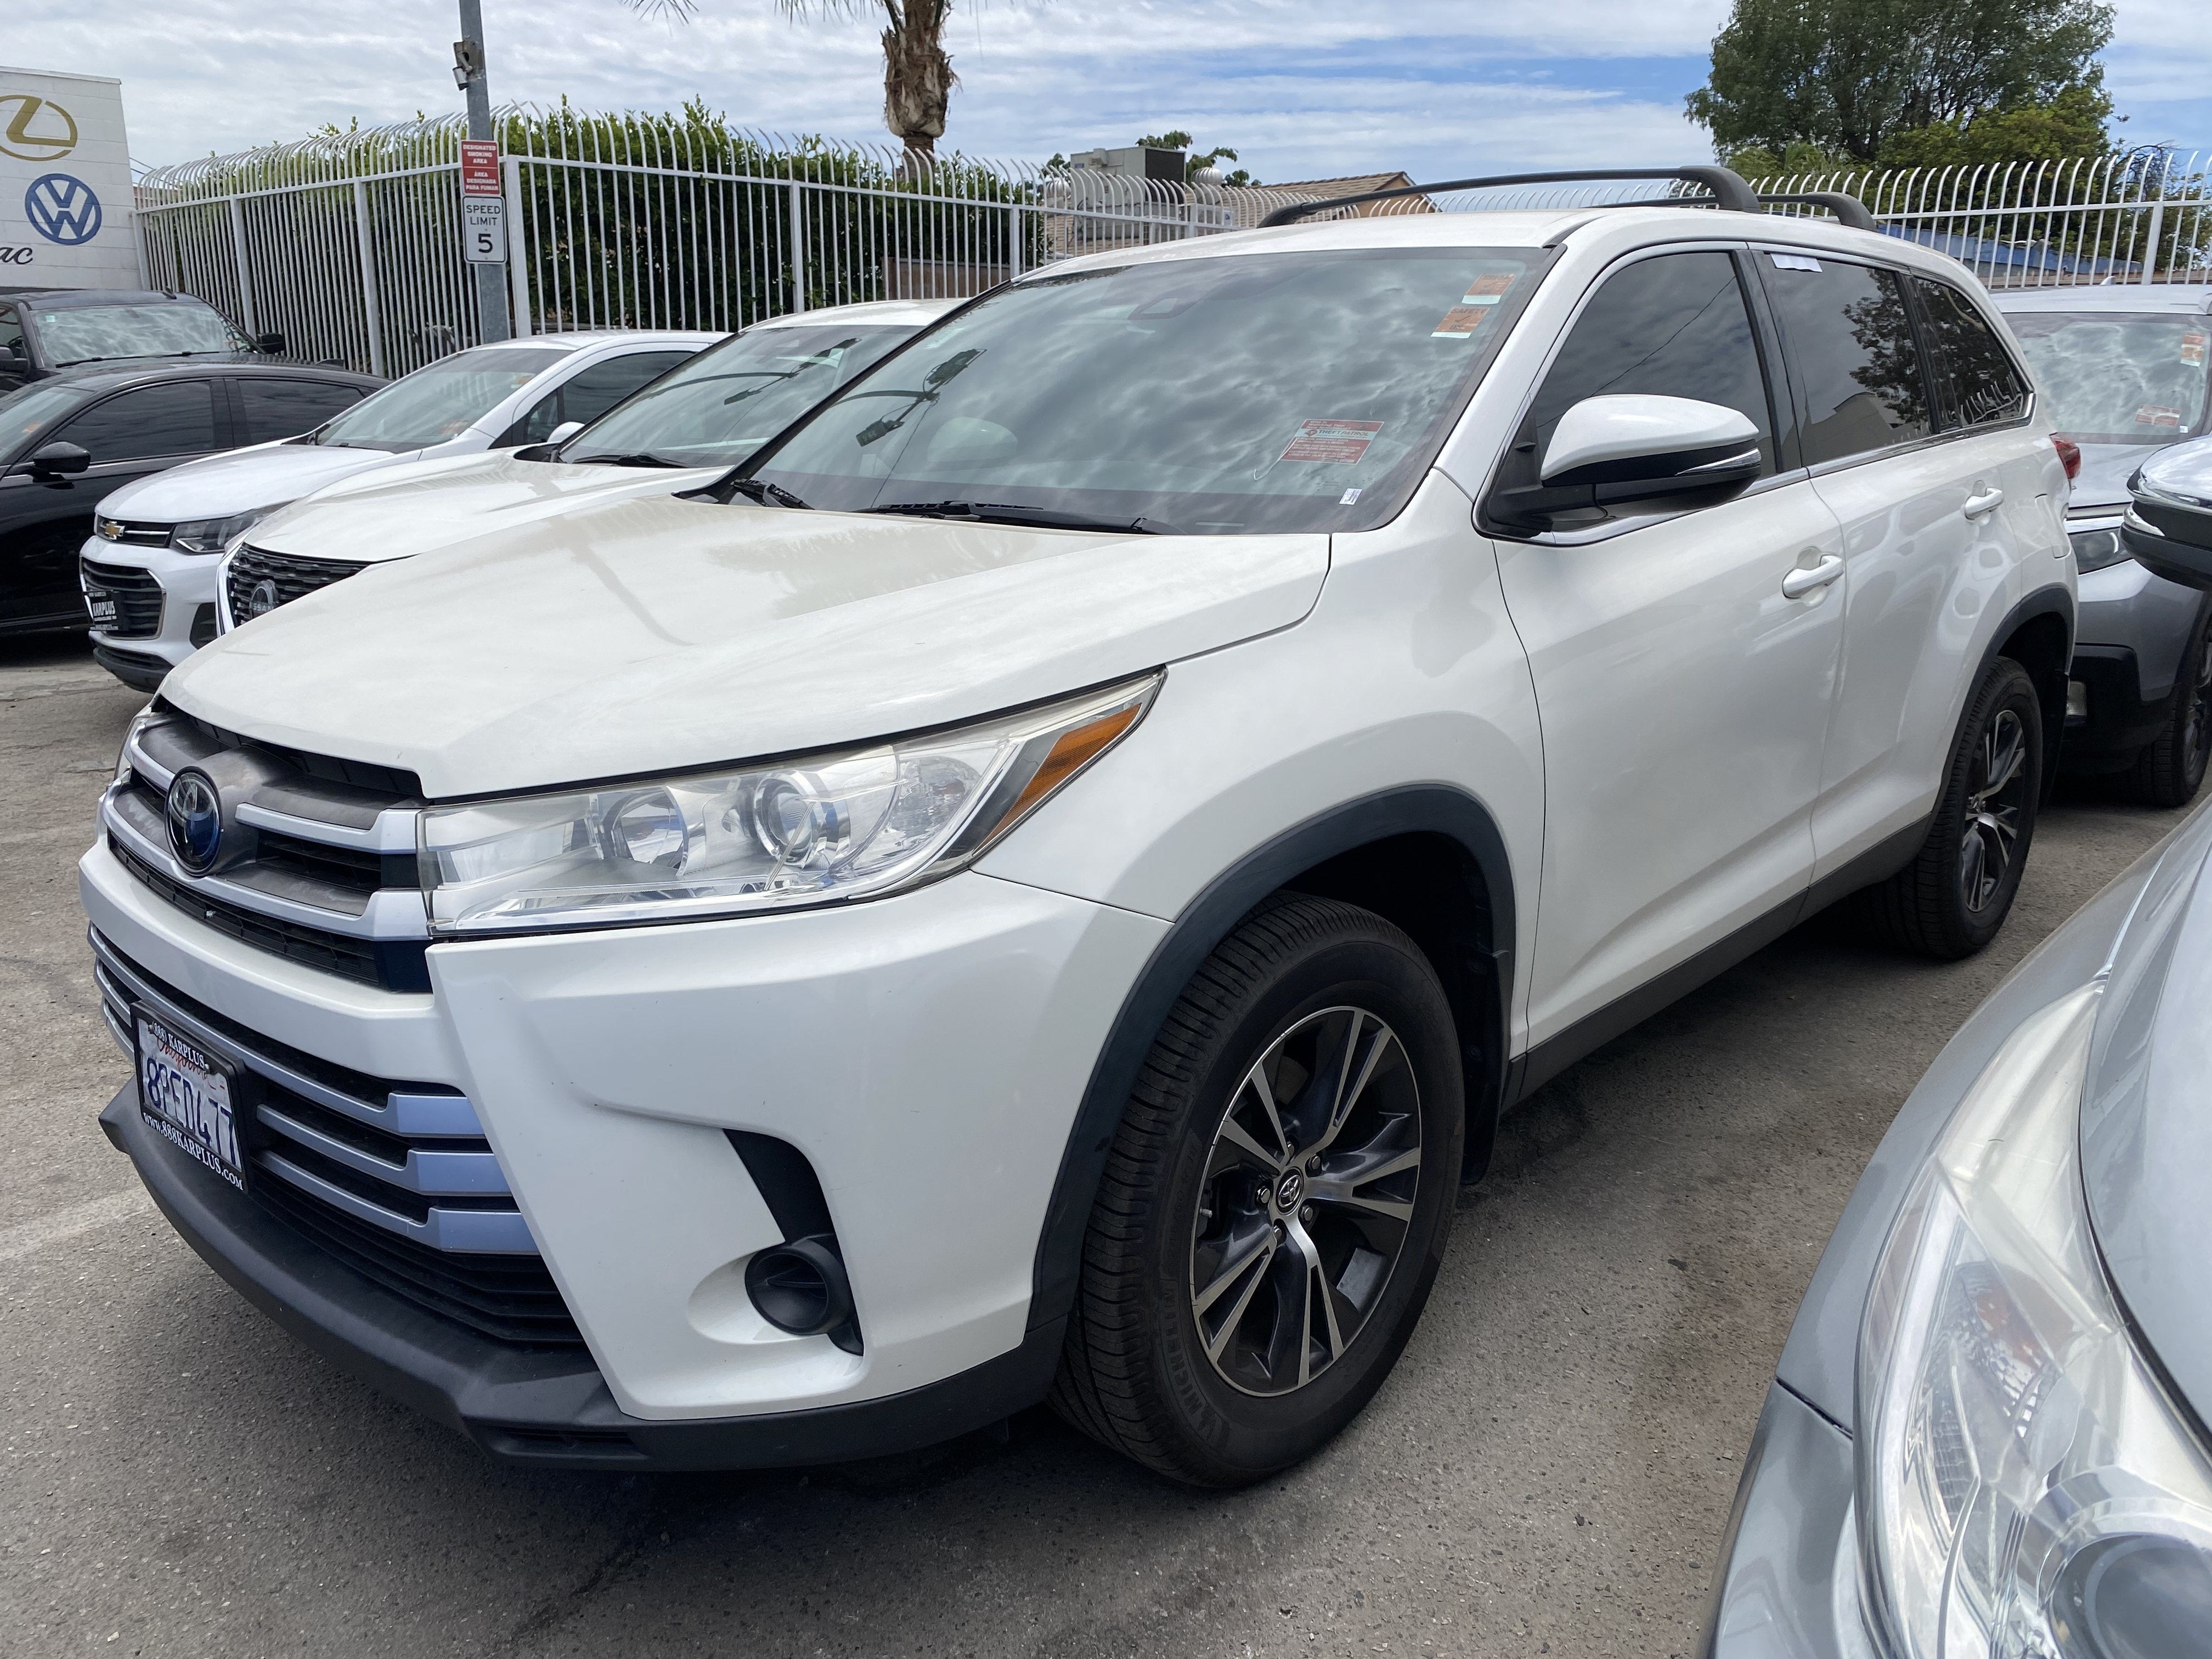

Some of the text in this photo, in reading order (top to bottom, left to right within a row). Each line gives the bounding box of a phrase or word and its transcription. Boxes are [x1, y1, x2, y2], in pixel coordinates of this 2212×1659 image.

[466, 205, 500, 214] SPEED
[470, 217, 498, 225] LIMIT
[478, 233, 493, 253] 5
[92, 600, 116, 617] KARPLUS
[168, 1033, 205, 1069] KARPLUS
[1163, 1286, 1202, 1415] MICHELIN
